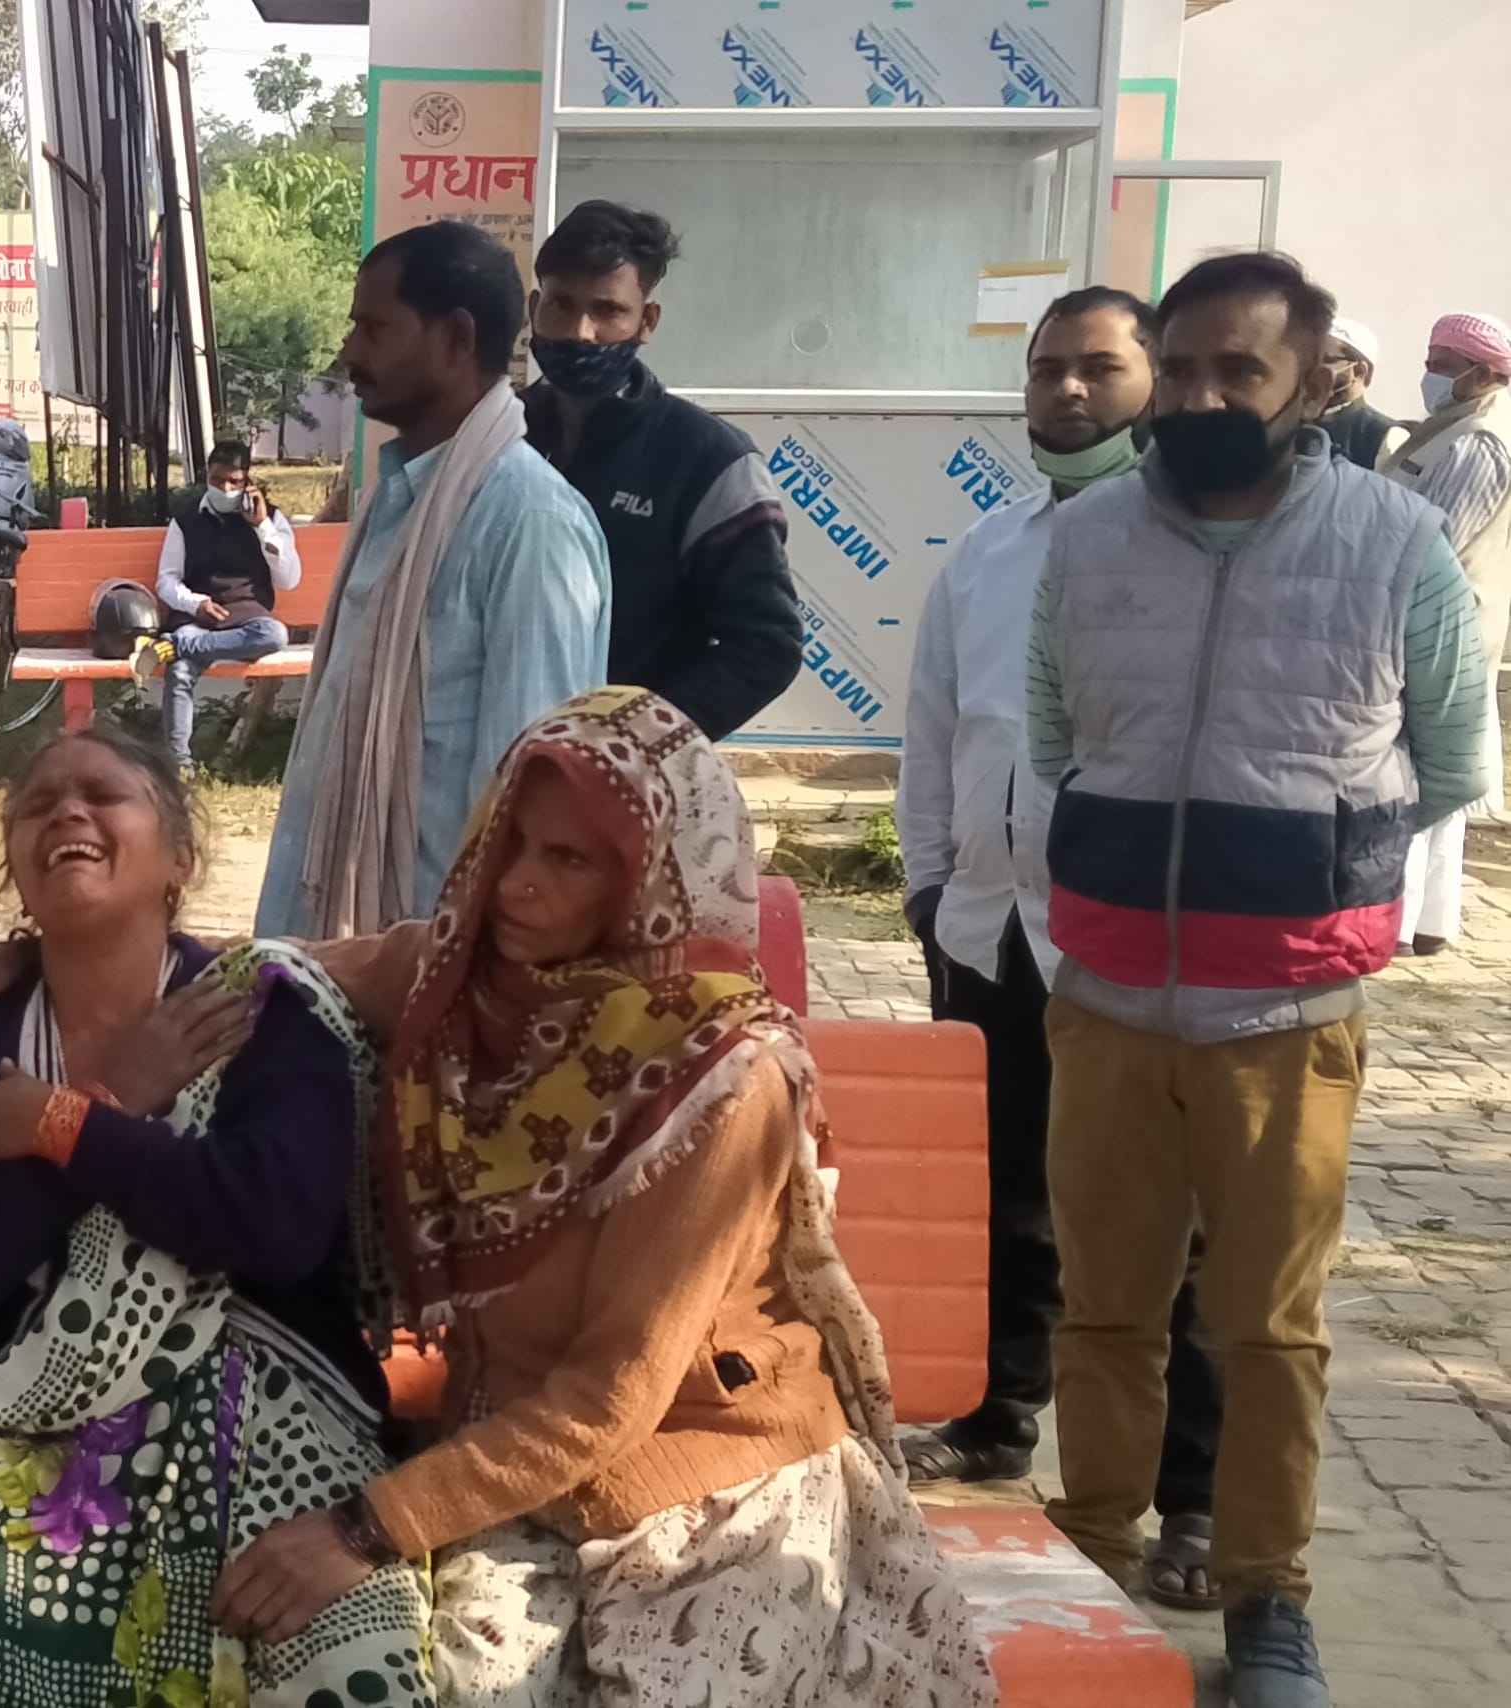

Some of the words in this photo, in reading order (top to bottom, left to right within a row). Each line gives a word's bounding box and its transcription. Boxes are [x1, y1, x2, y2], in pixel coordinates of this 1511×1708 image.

[781, 434, 833, 487] DECOR
[962, 436, 1015, 489] DECOR
[610, 490, 653, 517] FILA
[768, 446, 890, 580] IMPERIA
[802, 632, 883, 723] IMPE
